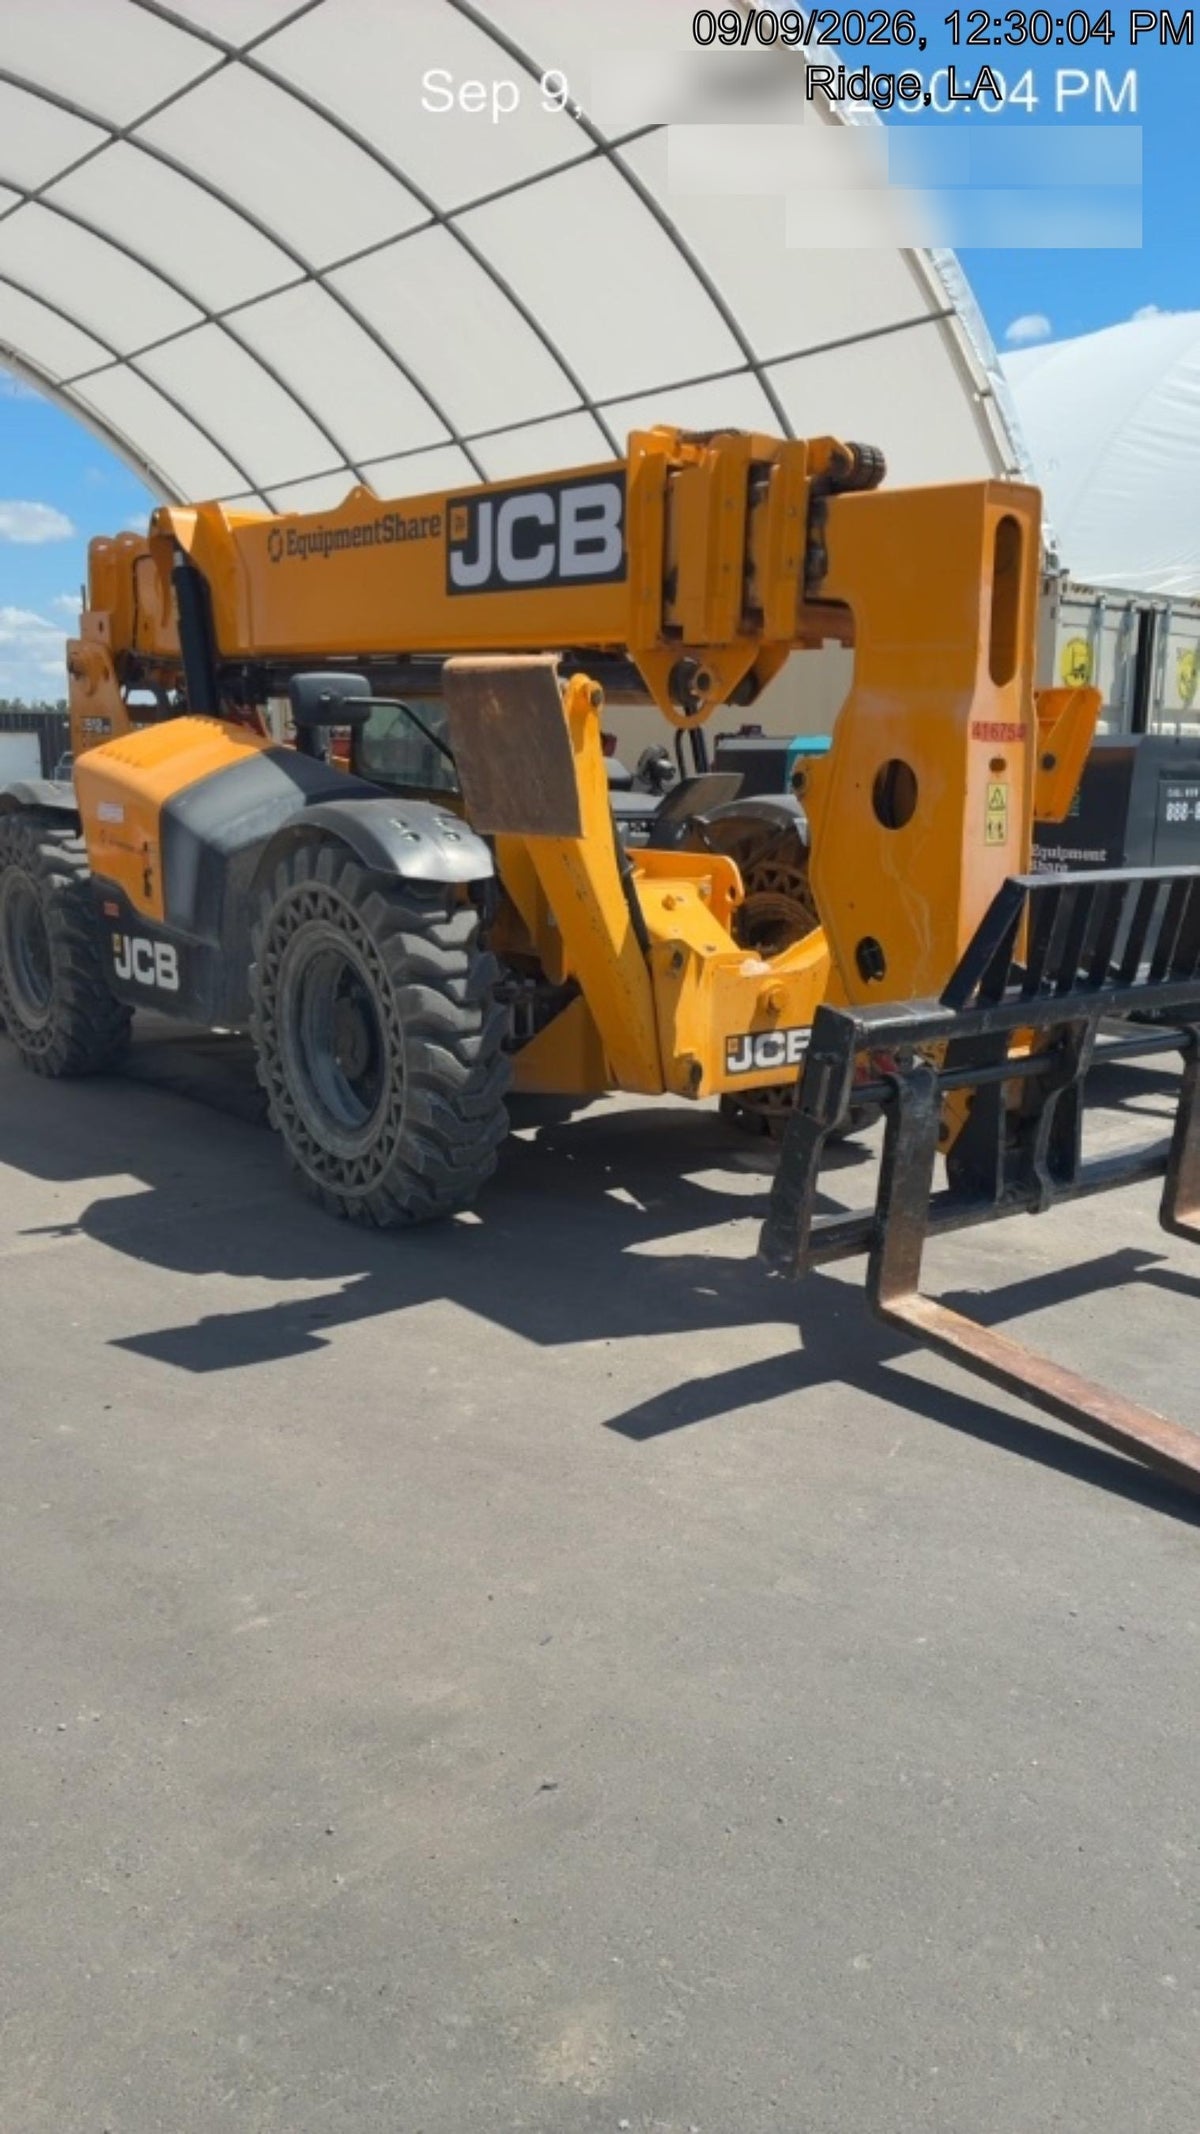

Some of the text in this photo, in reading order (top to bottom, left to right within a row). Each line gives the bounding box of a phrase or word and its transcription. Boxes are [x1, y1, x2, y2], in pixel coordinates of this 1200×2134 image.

[286, 512, 442, 560] EquipmentShare
[450, 483, 623, 587] JCB
[113, 934, 178, 990] JCB
